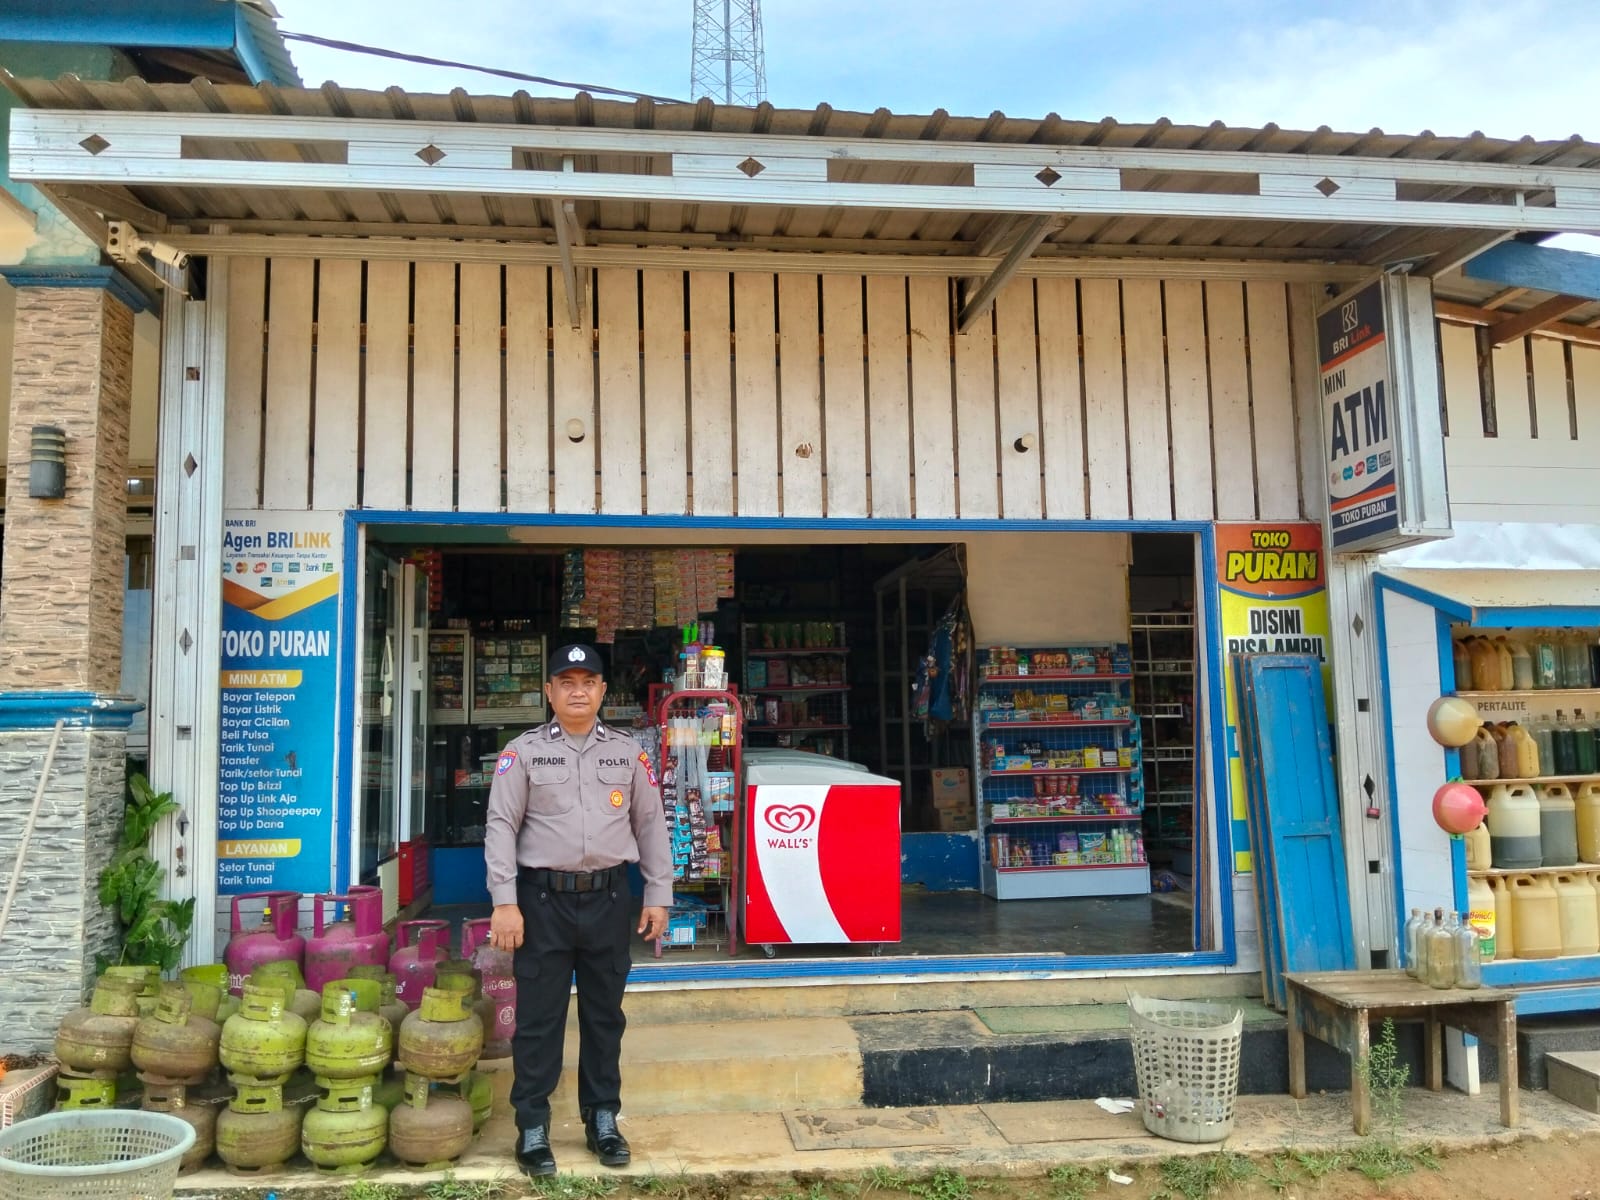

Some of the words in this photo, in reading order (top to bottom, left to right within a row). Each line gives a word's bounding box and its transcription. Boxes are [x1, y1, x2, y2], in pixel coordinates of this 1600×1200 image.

[1333, 336, 1348, 354] BRI
[1324, 368, 1346, 396] MINI
[1331, 380, 1388, 462] ATM
[1341, 508, 1361, 525] TOKO
[1361, 500, 1387, 519] PURAN
[225, 519, 243, 527] BANK
[245, 519, 256, 527] BRI
[223, 531, 261, 551] Agen
[267, 532, 331, 548] BRILINK
[1252, 532, 1289, 547] TOKO
[1227, 552, 1317, 581] PURAN
[1250, 609, 1301, 635] DISINI
[220, 630, 263, 657] TOKO
[269, 630, 330, 656] PURAN
[229, 673, 256, 684] MINI
[260, 673, 287, 684] ATM
[223, 693, 253, 703] Bayar
[255, 692, 295, 703] Telepon
[222, 705, 252, 715] Bayar
[255, 705, 282, 714] Listrik
[1477, 701, 1527, 711] PERTALITE
[222, 718, 251, 728] Bayar
[254, 718, 290, 727] Cicilan
[222, 731, 240, 740] Beli
[243, 731, 269, 740] Pulsa
[221, 743, 245, 752] Tarik
[247, 743, 274, 752] Tunai
[220, 756, 260, 765] Transfer
[532, 757, 566, 766] PRIADIE
[598, 758, 630, 767] POLRI
[220, 769, 273, 778] Tarik/setor
[276, 768, 302, 777] Tunai
[220, 782, 238, 792] Top
[241, 781, 255, 792] Up
[257, 781, 282, 790] Brizzi
[219, 795, 238, 805] Top
[240, 794, 254, 805] Up
[257, 794, 277, 803] Link
[279, 794, 297, 805] Aja
[219, 808, 237, 818] Top
[240, 807, 254, 818] Up
[257, 807, 322, 817] Shoopeepay
[219, 821, 237, 831] Top
[240, 820, 253, 831] Up
[256, 820, 284, 829] Dana
[225, 843, 288, 855] LAYANAN
[767, 838, 809, 849] WALL'S
[219, 862, 245, 872] Setor
[248, 862, 275, 871] Tunai
[219, 876, 243, 885] Tarik
[245, 875, 273, 884] Tunai
